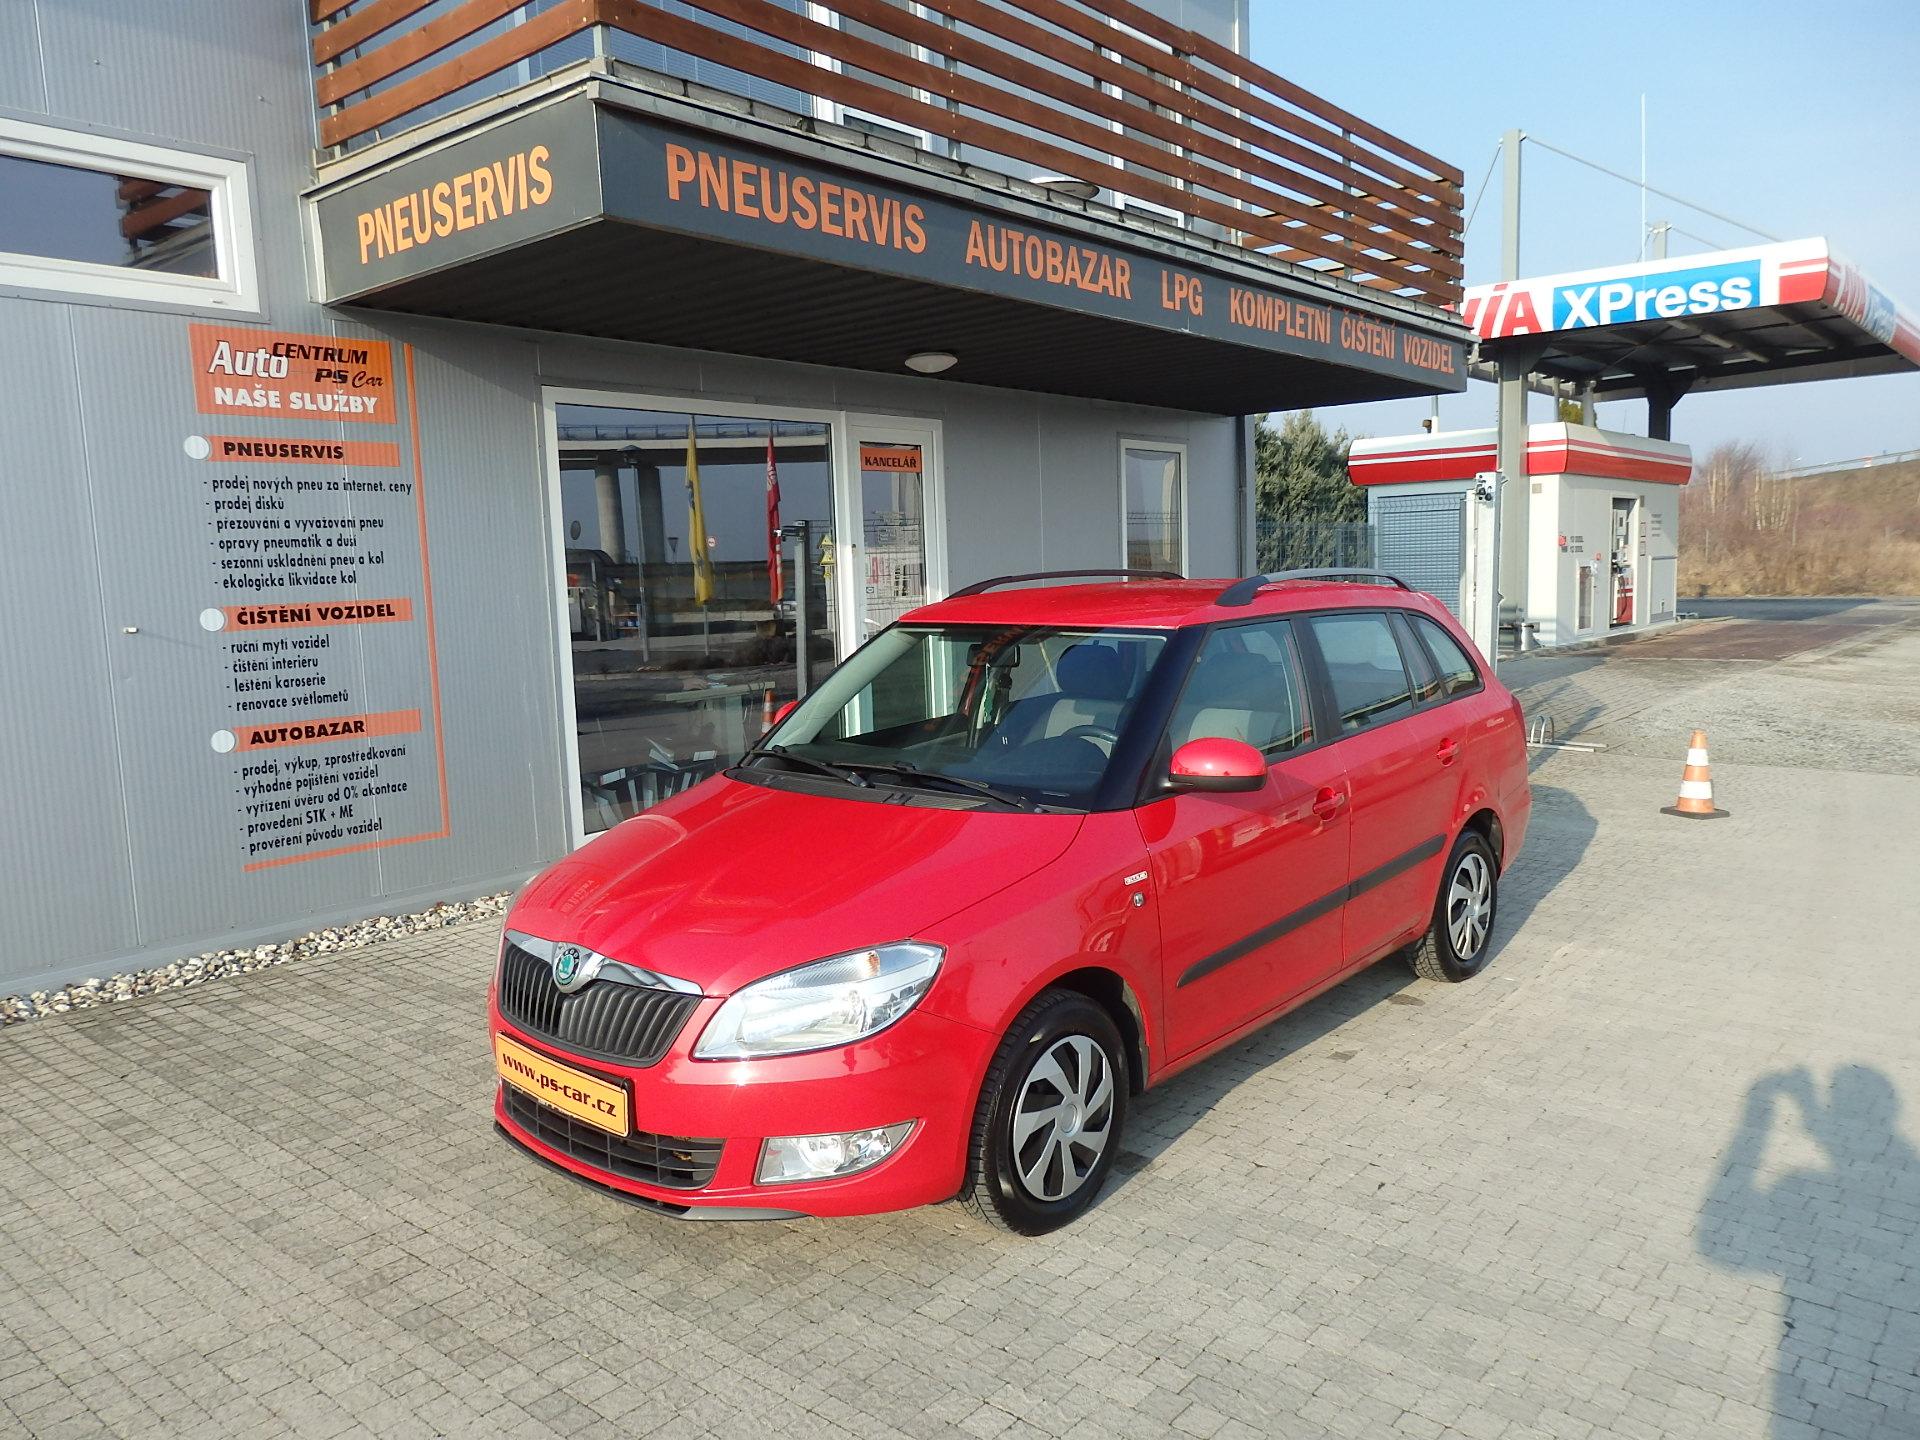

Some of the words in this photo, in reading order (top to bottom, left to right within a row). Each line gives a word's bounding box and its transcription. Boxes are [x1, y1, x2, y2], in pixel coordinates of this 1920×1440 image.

[357, 145, 553, 265] PNEUSERVIS
[665, 142, 927, 254] PNEUSERVIS
[965, 219, 1132, 300] AUTOBAZAR
[1161, 269, 1204, 316] LPG
[1229, 286, 1332, 345] KOMPLETNÍ
[1340, 310, 1396, 360] ČIŠTĚNÍ
[1403, 333, 1455, 375] VOZIDEL
[1561, 276, 1752, 330] XPress
[207, 339, 289, 379] Auto
[272, 342, 368, 365] CENTRUM
[315, 368, 349, 384] PS
[352, 370, 383, 388] Car
[214, 384, 282, 409] NAŠE
[289, 389, 378, 414] SLUŽBY
[223, 441, 344, 459] PNEUSERVIS
[864, 456, 917, 468] KANCELÁŘ
[213, 475, 250, 493] prodej
[253, 476, 293, 493] nových
[297, 481, 323, 494] pneu
[327, 482, 339, 490] za
[390, 483, 412, 495] ceny
[215, 495, 252, 513] prodej
[284, 520, 291, 529] a
[360, 518, 384, 531] pneu
[219, 539, 259, 553] opravy
[263, 534, 322, 552] pneumatik
[326, 539, 333, 547] a
[330, 556, 355, 569] pneu
[359, 556, 365, 565] a
[368, 551, 384, 564] kol
[288, 571, 337, 586] likvidace
[340, 570, 357, 584] kol
[237, 604, 310, 625] ČIŠTĚNÍ
[317, 604, 395, 621] VOZIDEL
[292, 634, 330, 649] vozidel
[275, 672, 326, 688] karoserie
[236, 697, 288, 711] renovace
[250, 720, 365, 745] AUTOBAZAR
[343, 764, 379, 781] vozidel
[328, 788, 340, 802] od
[344, 785, 359, 800] 0%
[362, 782, 408, 797] akontace
[306, 808, 327, 824] STK
[339, 804, 354, 818] ME
[347, 817, 382, 835] vozidel
[502, 1053, 617, 1117] www.ps-car.cz
